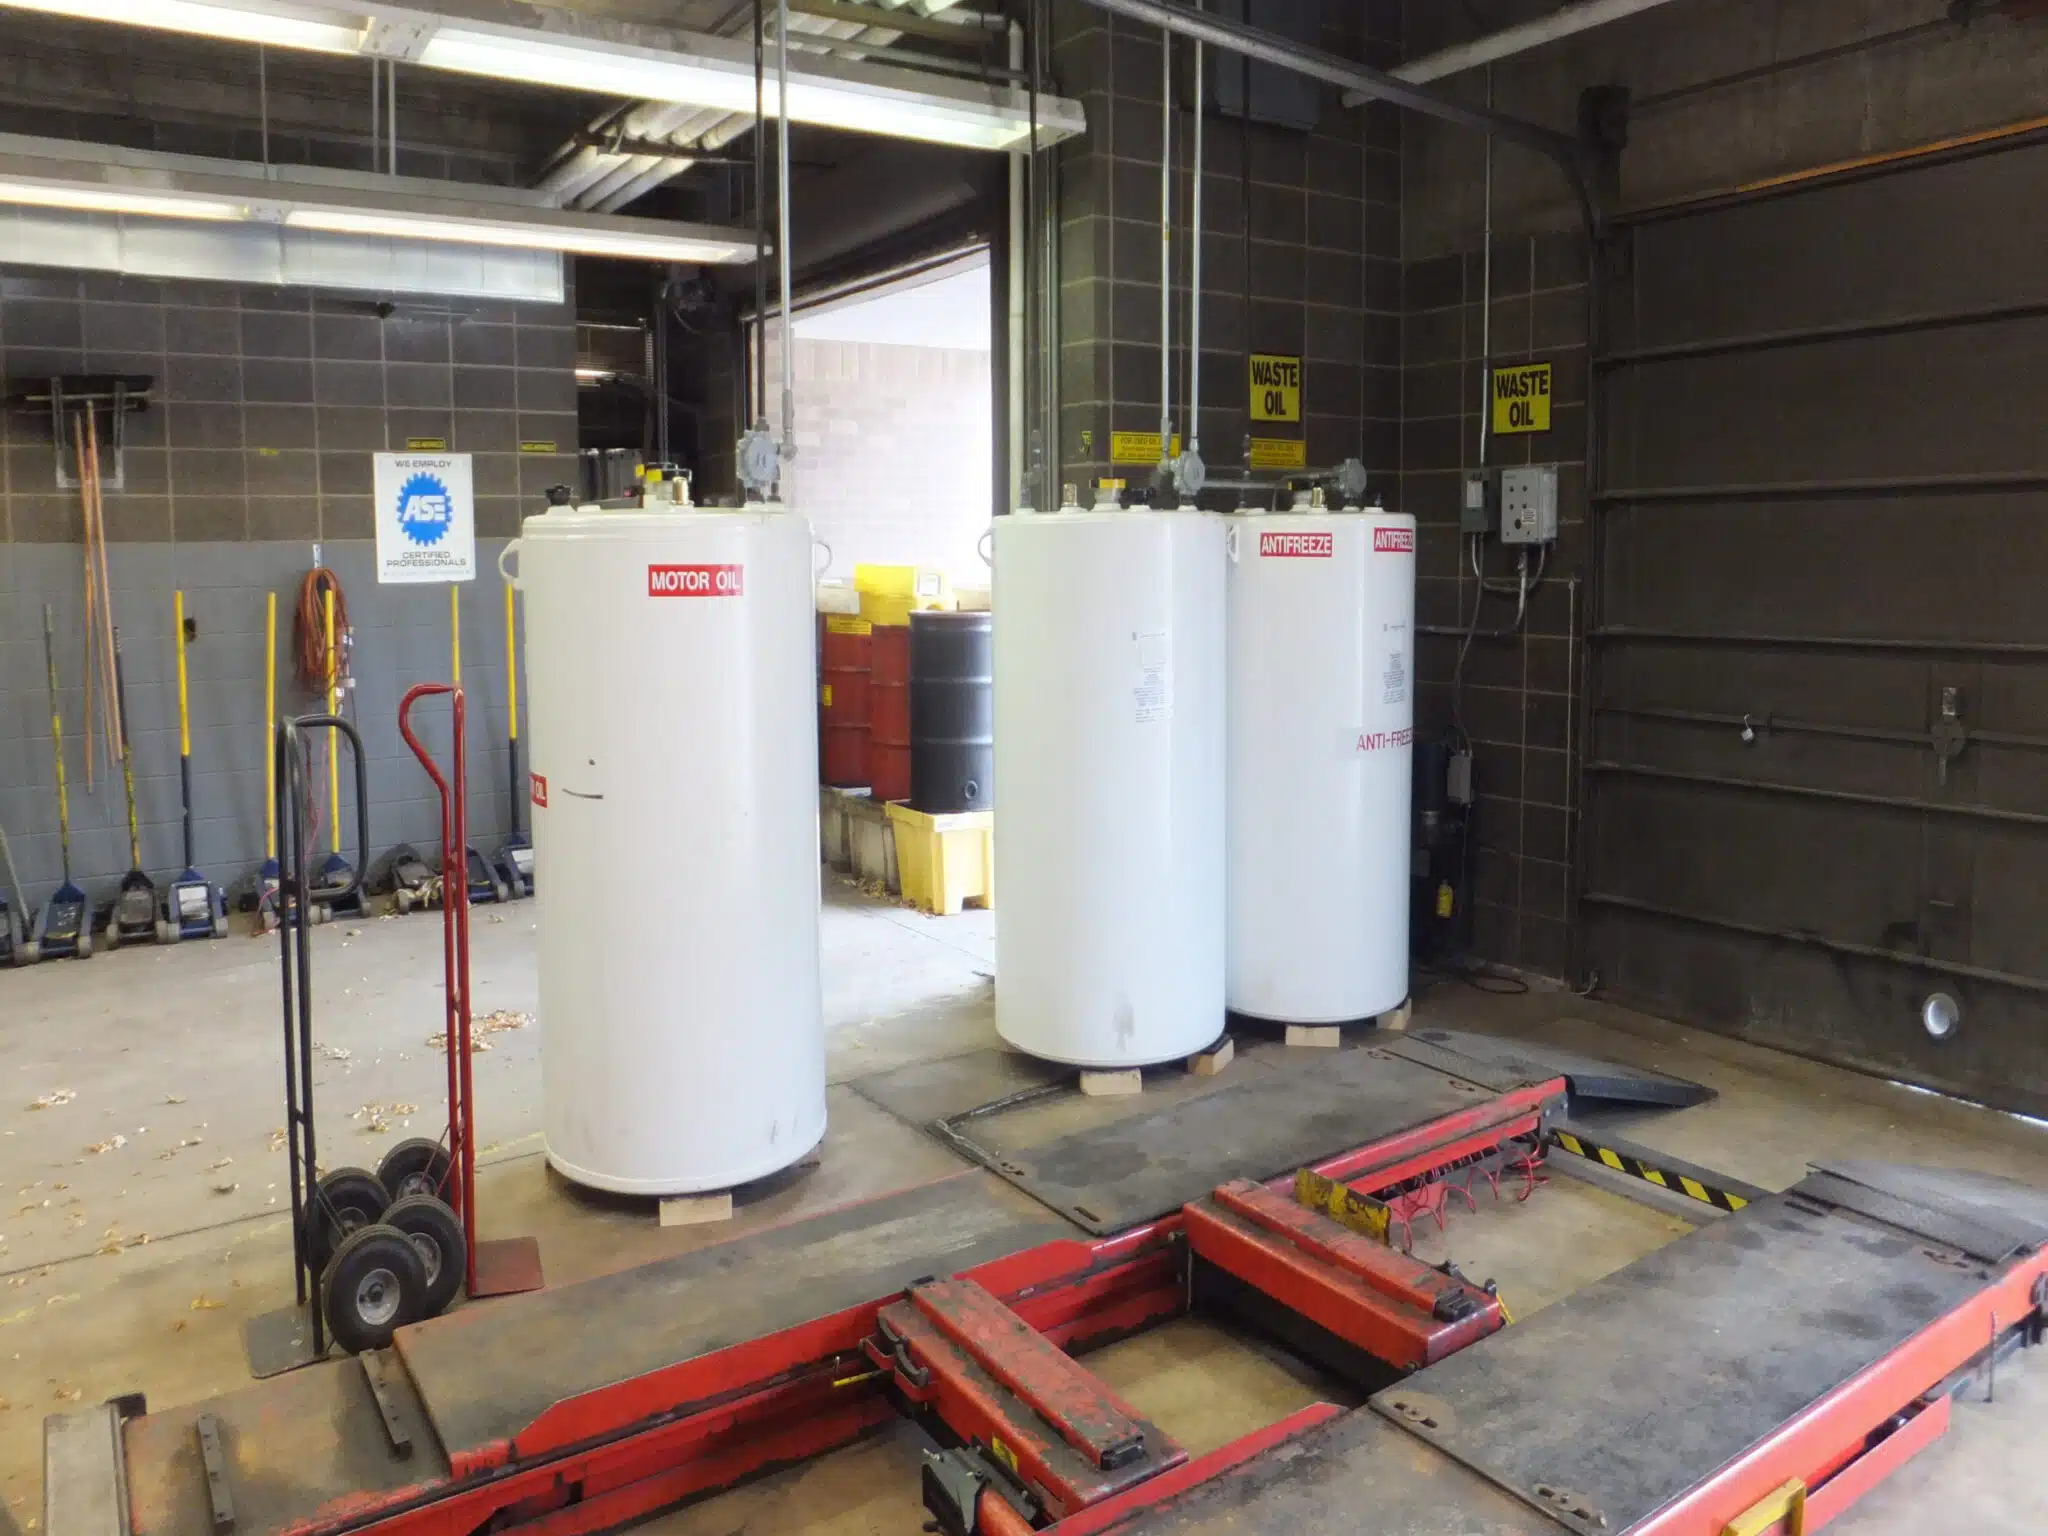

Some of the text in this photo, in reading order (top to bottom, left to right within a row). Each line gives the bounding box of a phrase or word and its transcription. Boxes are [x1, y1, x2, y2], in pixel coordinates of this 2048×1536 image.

[1252, 361, 1298, 388] WASTE
[1496, 370, 1549, 399] WASTE
[1264, 391, 1287, 415] OIL
[1508, 401, 1534, 427] OIL
[395, 460, 452, 468] WE EMPLOY
[402, 495, 446, 521] ASE
[1261, 535, 1333, 554] ANTIFREEZE
[386, 559, 467, 567] PROFESSIONALS
[402, 551, 451, 559] CERTIFIED
[651, 571, 740, 590] MOTOR OIL
[535, 781, 546, 800] OIL
